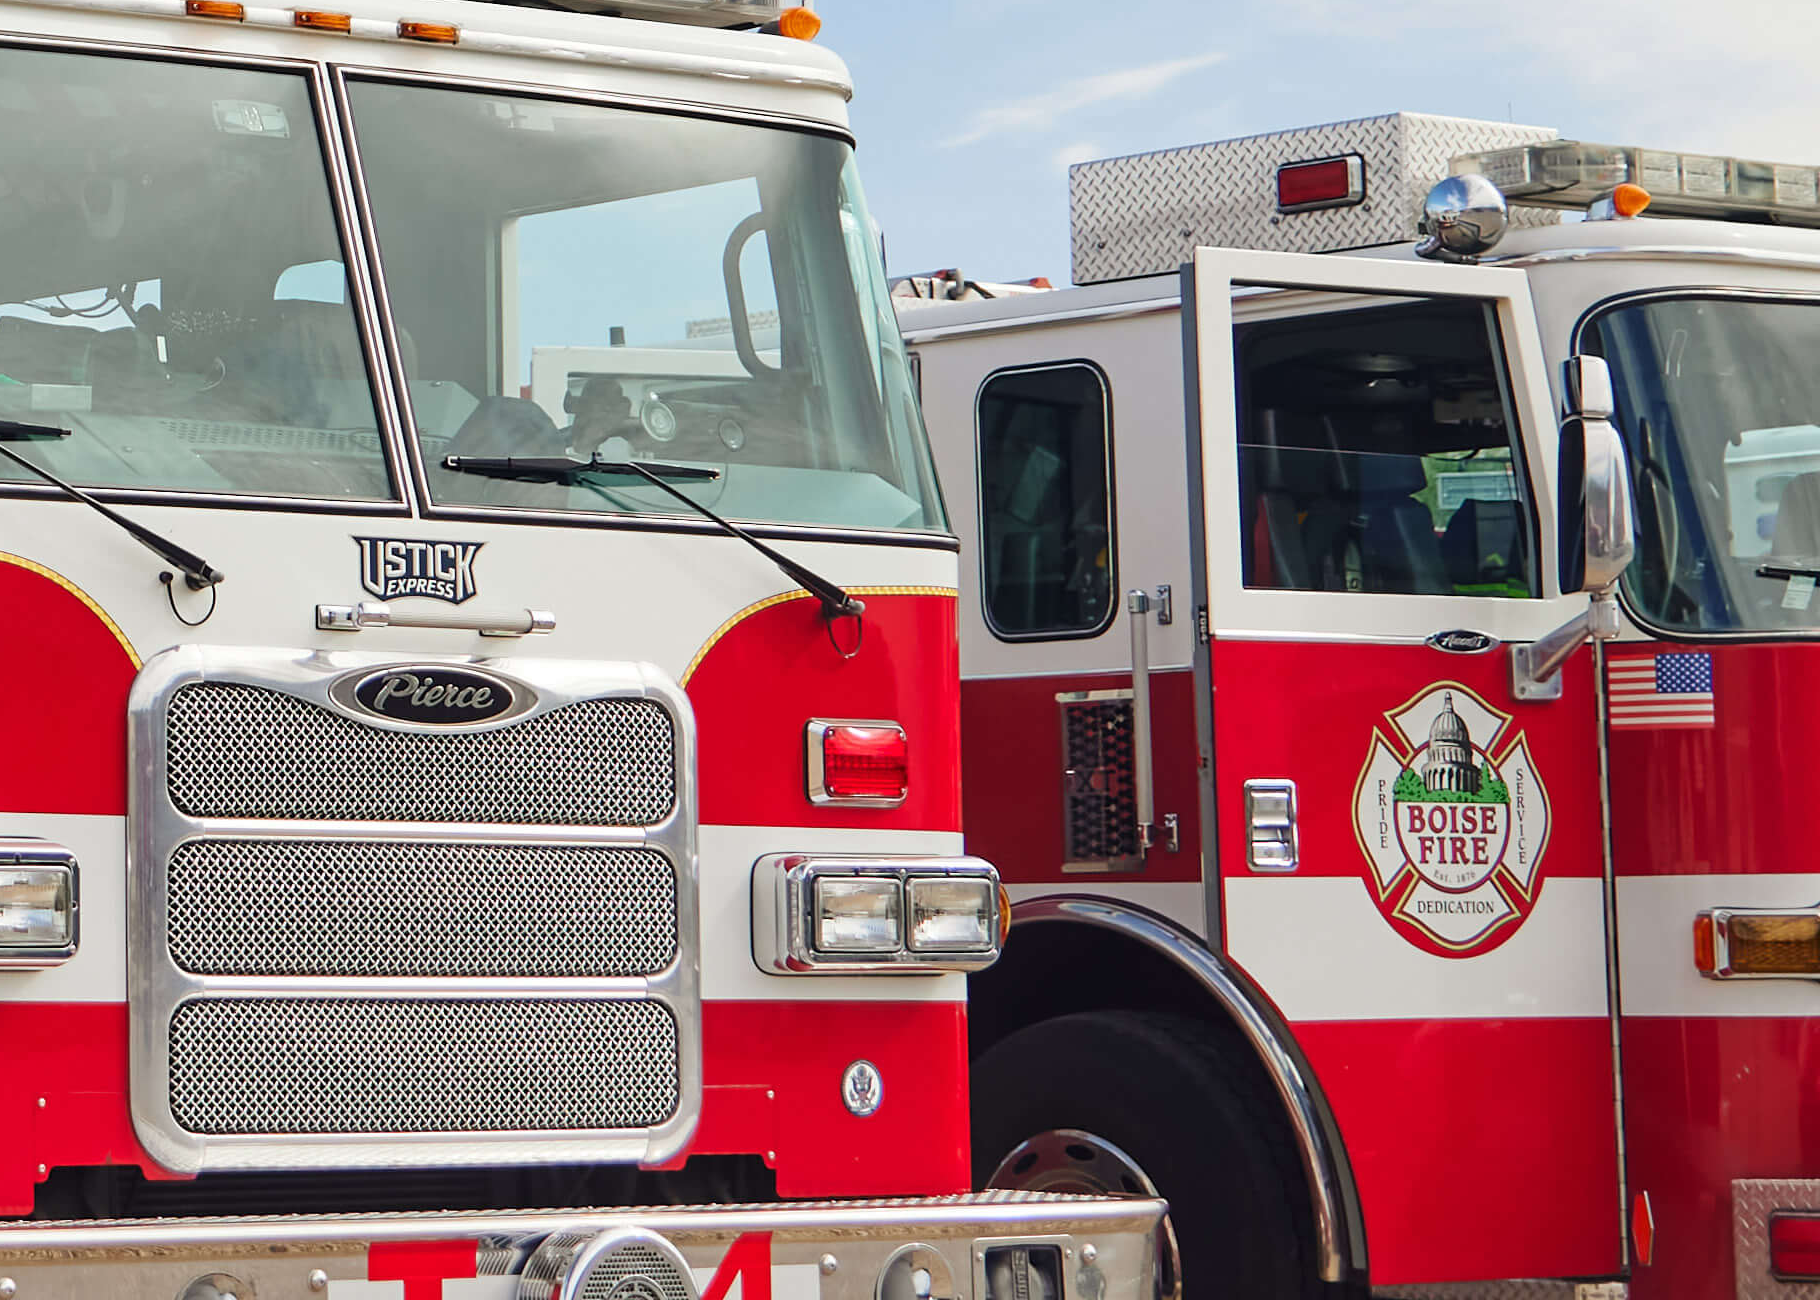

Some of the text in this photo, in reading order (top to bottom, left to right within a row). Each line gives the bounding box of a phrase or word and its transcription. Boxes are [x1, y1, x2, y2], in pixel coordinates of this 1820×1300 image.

[360, 539, 477, 601] USTICK
[386, 578, 455, 599] EXPRESS
[373, 673, 494, 710] Pierce
[1378, 780, 1388, 849] PRIDE
[1407, 804, 1497, 834] BOISE
[1516, 768, 1527, 864] SERVICE
[1418, 836, 1490, 865] FIRE
[1417, 900, 1495, 915] DEDICATION
